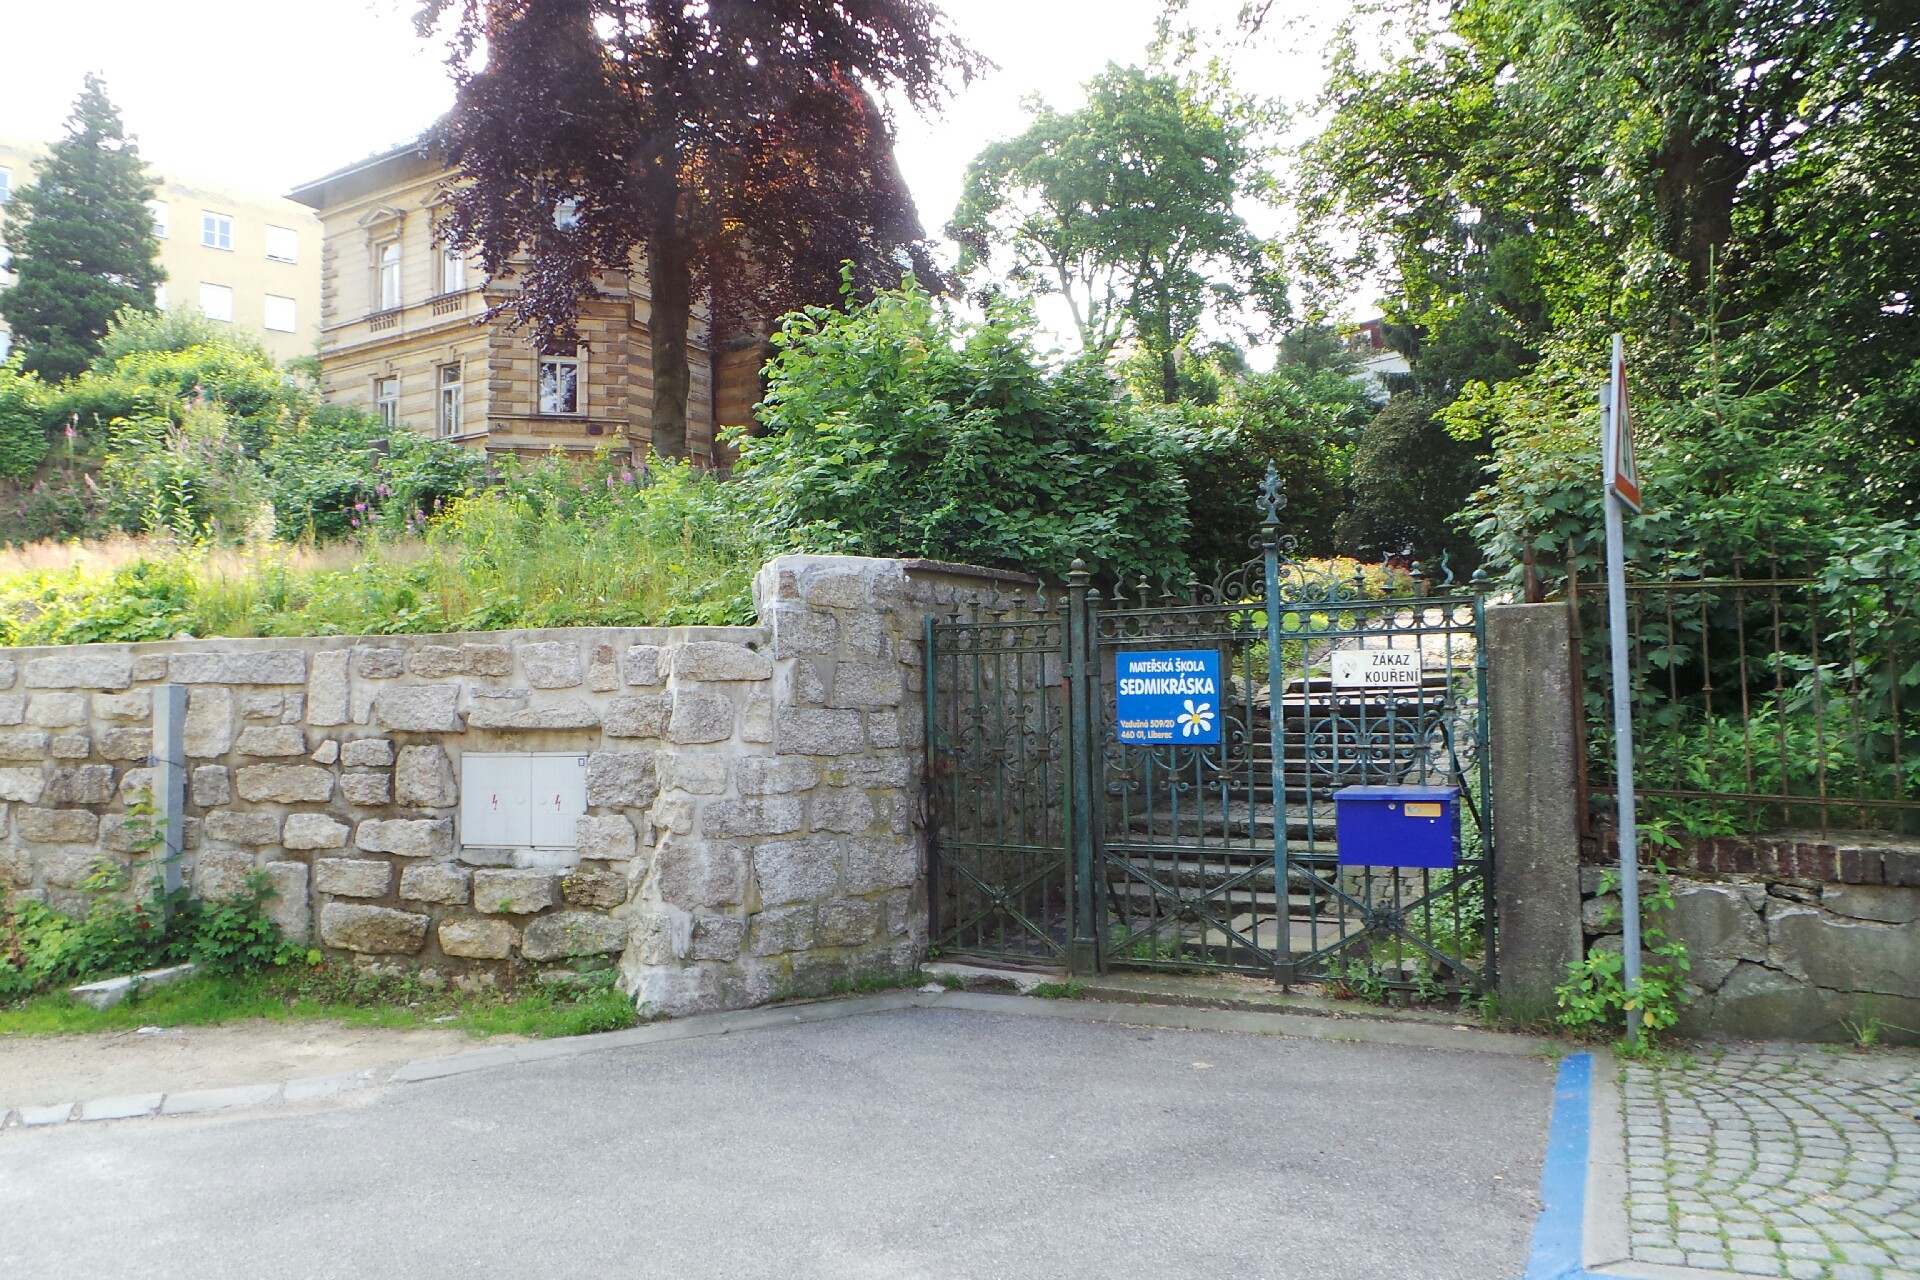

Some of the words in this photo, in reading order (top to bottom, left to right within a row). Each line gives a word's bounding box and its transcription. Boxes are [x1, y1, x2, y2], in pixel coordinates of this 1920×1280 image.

[1129, 658, 1174, 673] MATEŘSKÁ
[1175, 658, 1205, 672] ŠKOLA
[1372, 652, 1410, 666] ZÁKAZ
[1365, 667, 1419, 682] KOUŘENÍ
[1119, 673, 1215, 695] SEDMIKRÁSKA
[1121, 731, 1135, 739] 460
[1147, 731, 1173, 739] Liberec
